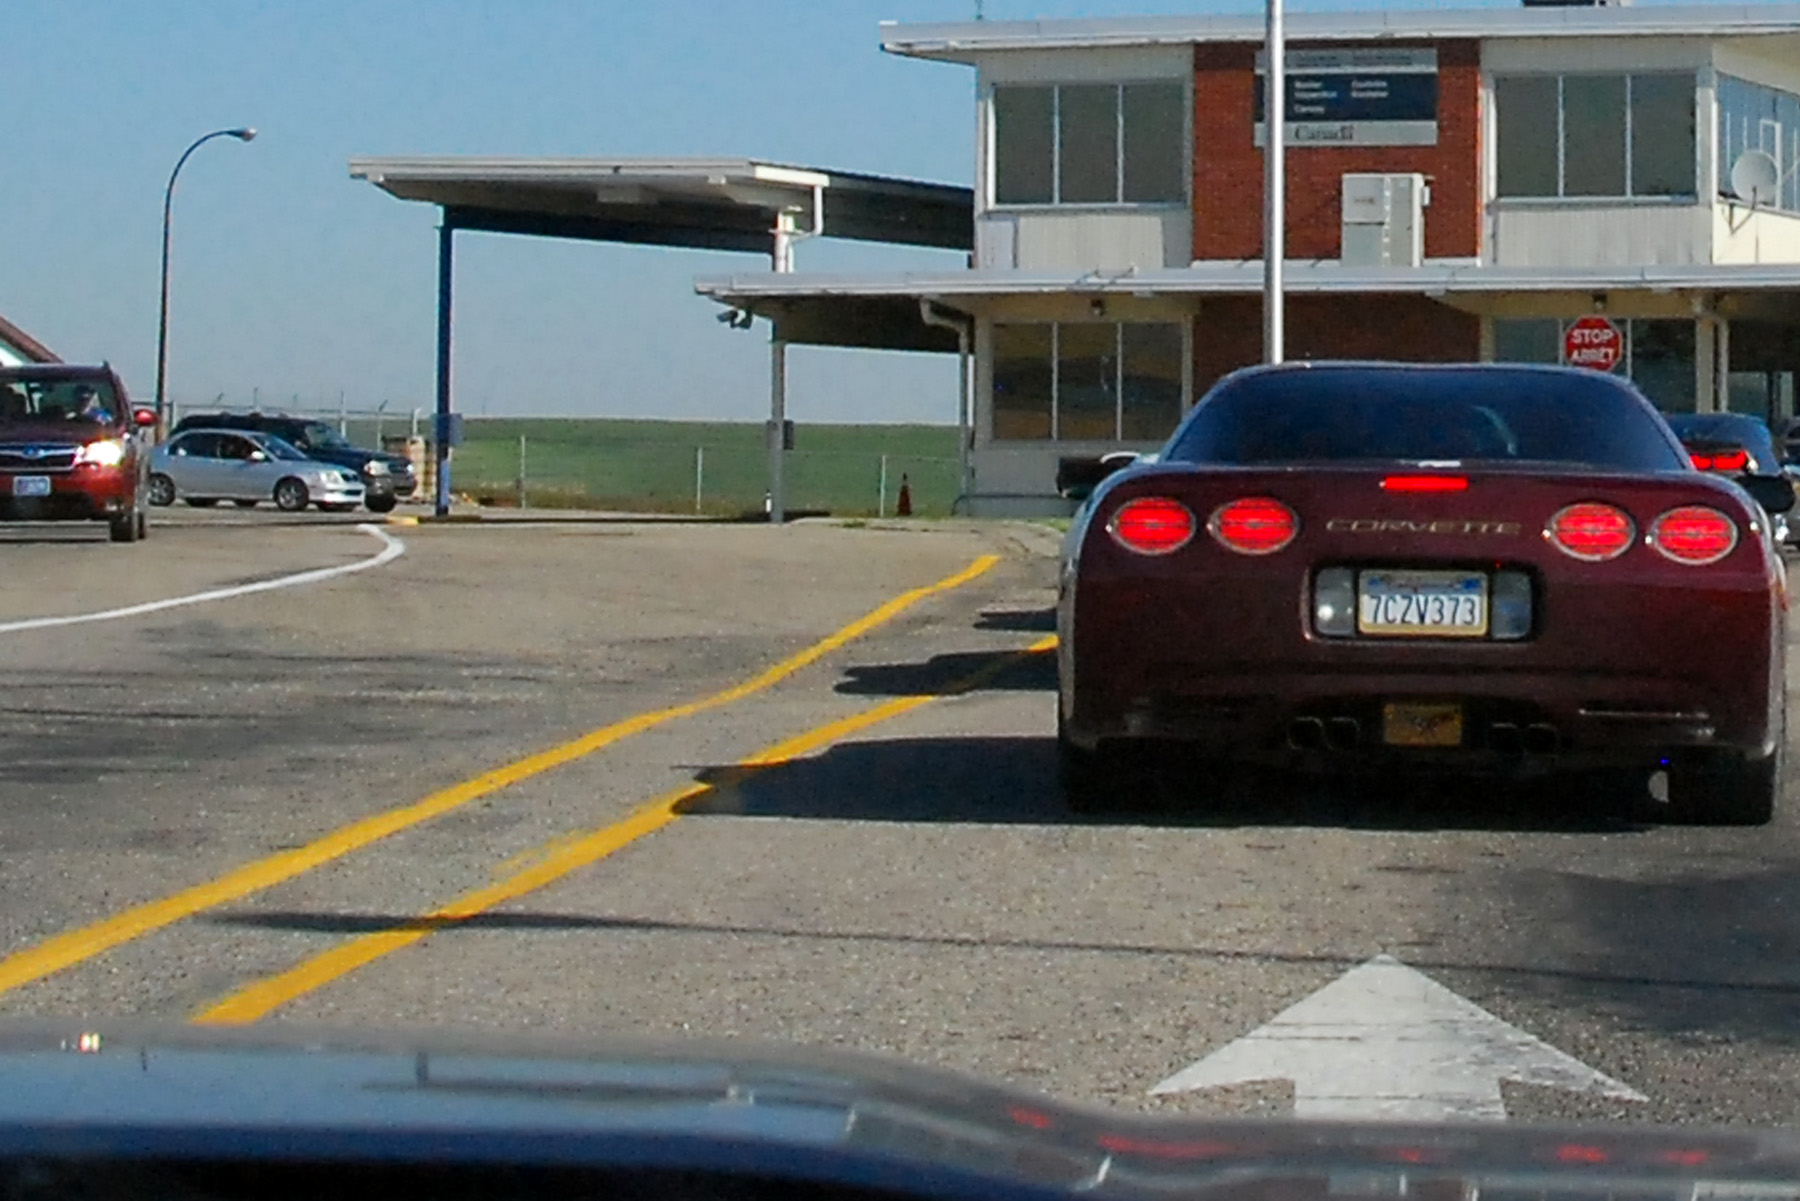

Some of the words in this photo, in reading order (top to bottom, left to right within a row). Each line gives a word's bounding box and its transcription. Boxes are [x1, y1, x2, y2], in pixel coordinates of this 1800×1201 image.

[1571, 328, 1614, 344] STOP
[1325, 519, 1523, 536] CORVETTE
[1369, 594, 1477, 625] 7CZV373
